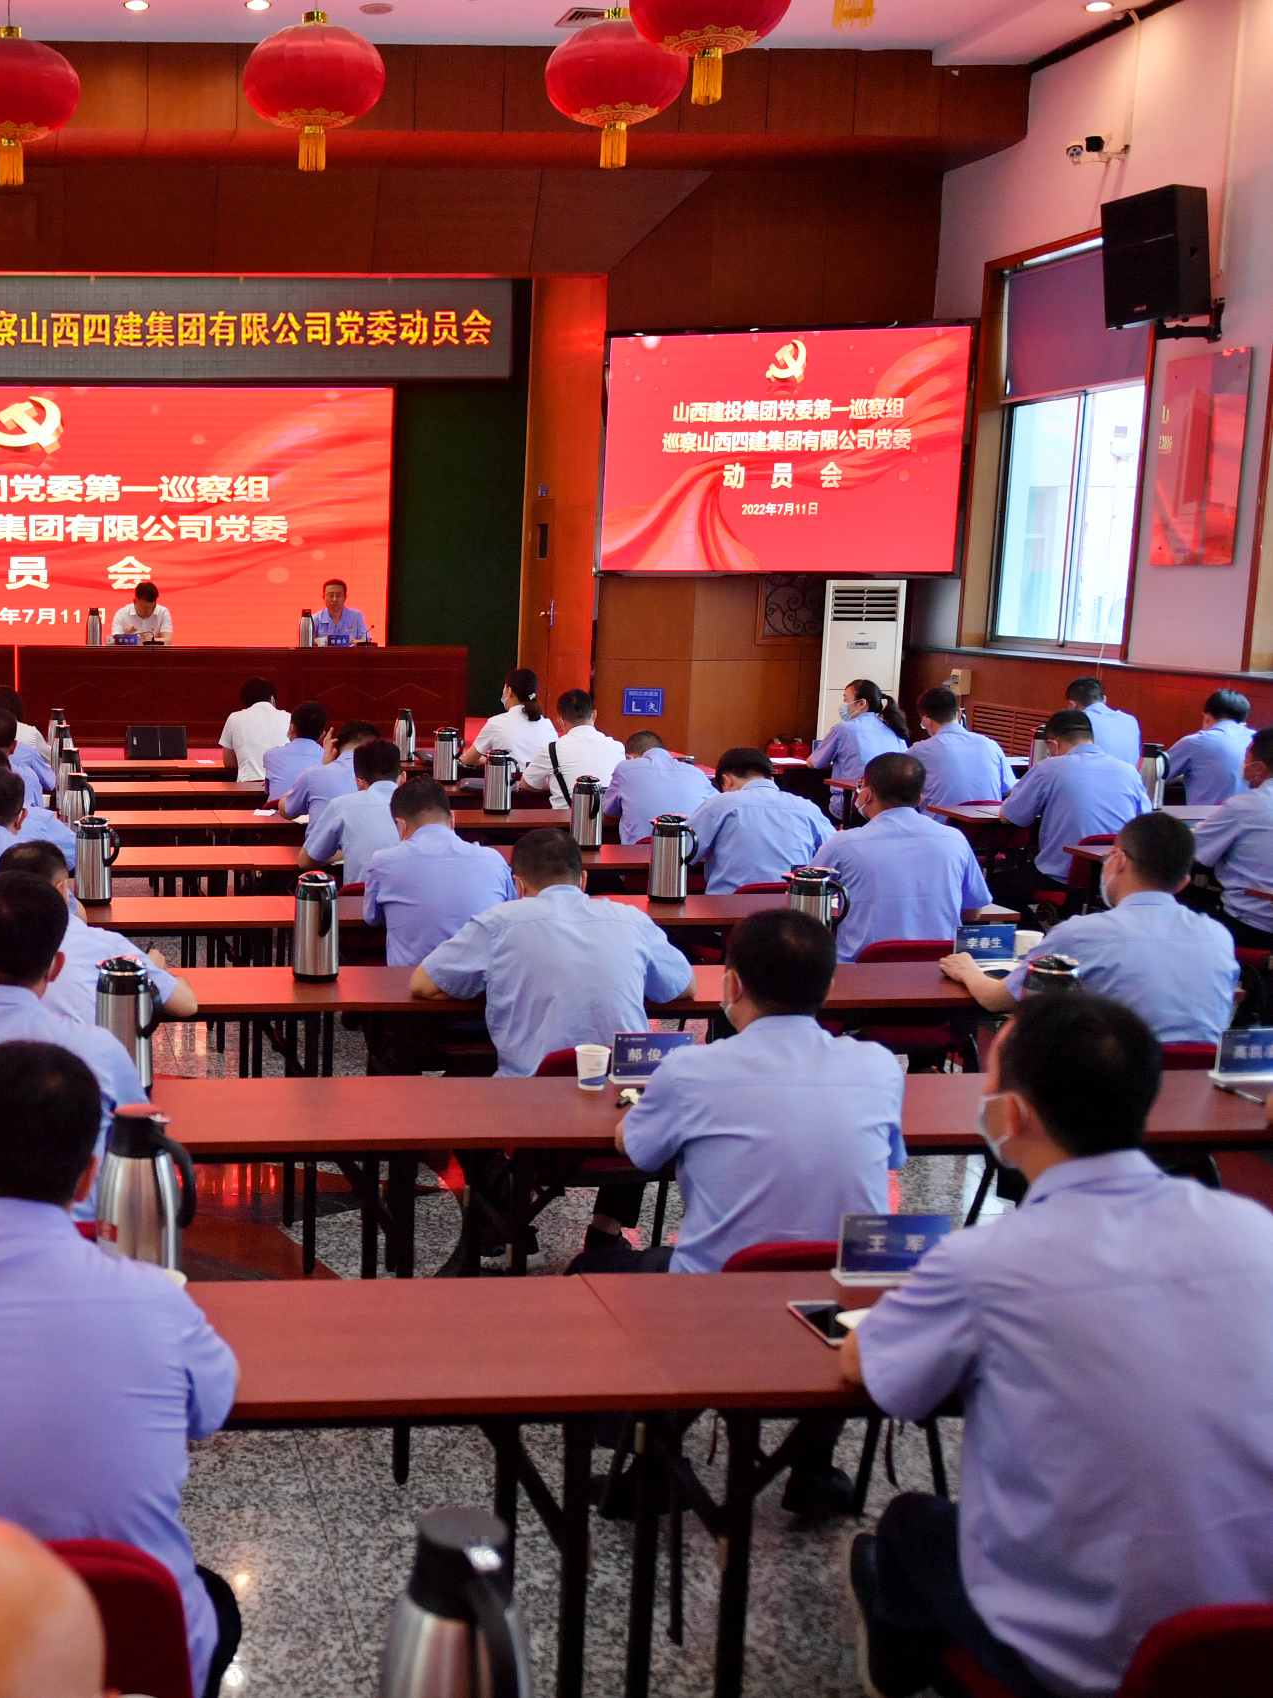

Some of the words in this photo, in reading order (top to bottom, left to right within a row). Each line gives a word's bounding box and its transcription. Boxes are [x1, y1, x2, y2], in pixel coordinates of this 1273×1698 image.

[673, 398, 905, 422] 山西建投集团党委第一巡察组
[662, 429, 912, 453] 巡察山西四建集团有限公司党委
[741, 502, 818, 516] 2022年7月11日
[966, 937, 1003, 949] 李春生
[627, 1048, 675, 1062] 郝俊
